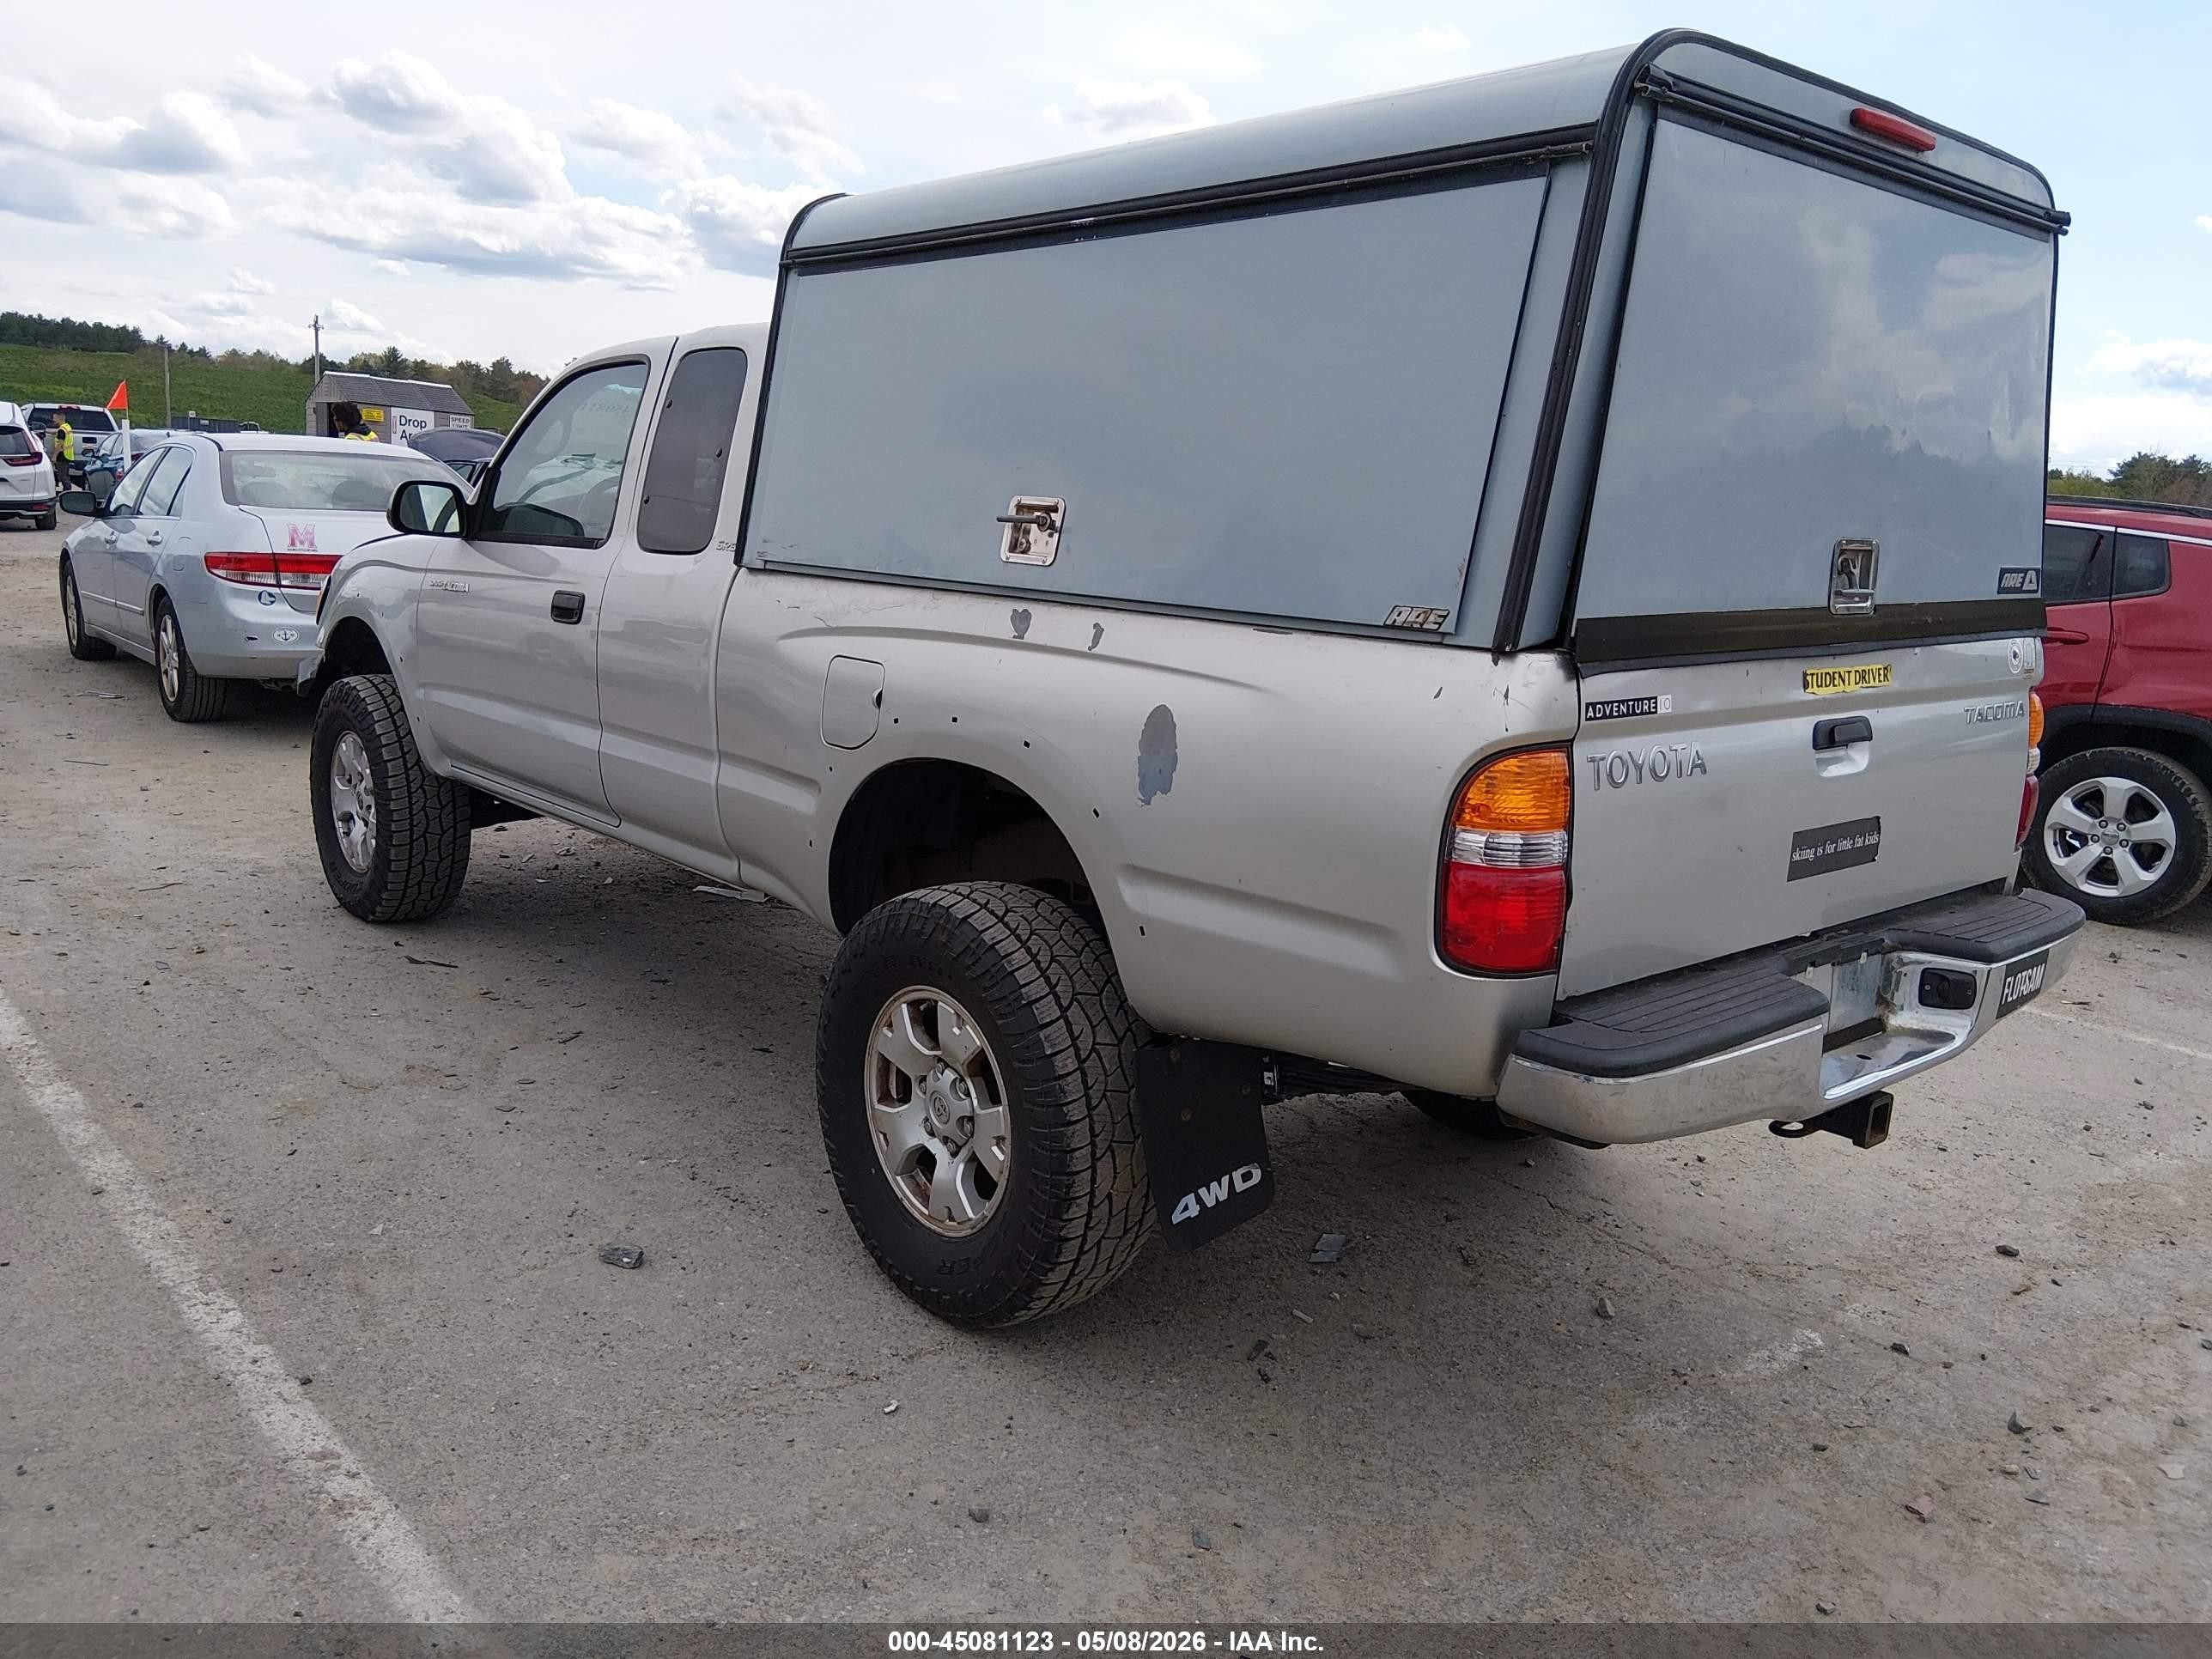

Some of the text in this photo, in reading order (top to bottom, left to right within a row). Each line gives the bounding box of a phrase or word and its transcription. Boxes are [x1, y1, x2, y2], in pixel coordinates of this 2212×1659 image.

[399, 415, 427, 430] Drop
[400, 429, 413, 441] Ar
[1383, 605, 1450, 631] ARE
[1804, 666, 1890, 690] STUDENT DRIVER
[1586, 699, 1657, 720] ADVENTURE
[1964, 700, 2025, 724] TACOMA
[1586, 740, 1708, 792] TOYOTA
[1791, 830, 1880, 862] skiing is for little fat kids
[2001, 963, 2045, 1006] FLOTSAM
[1170, 1162, 1263, 1225] 4WD
